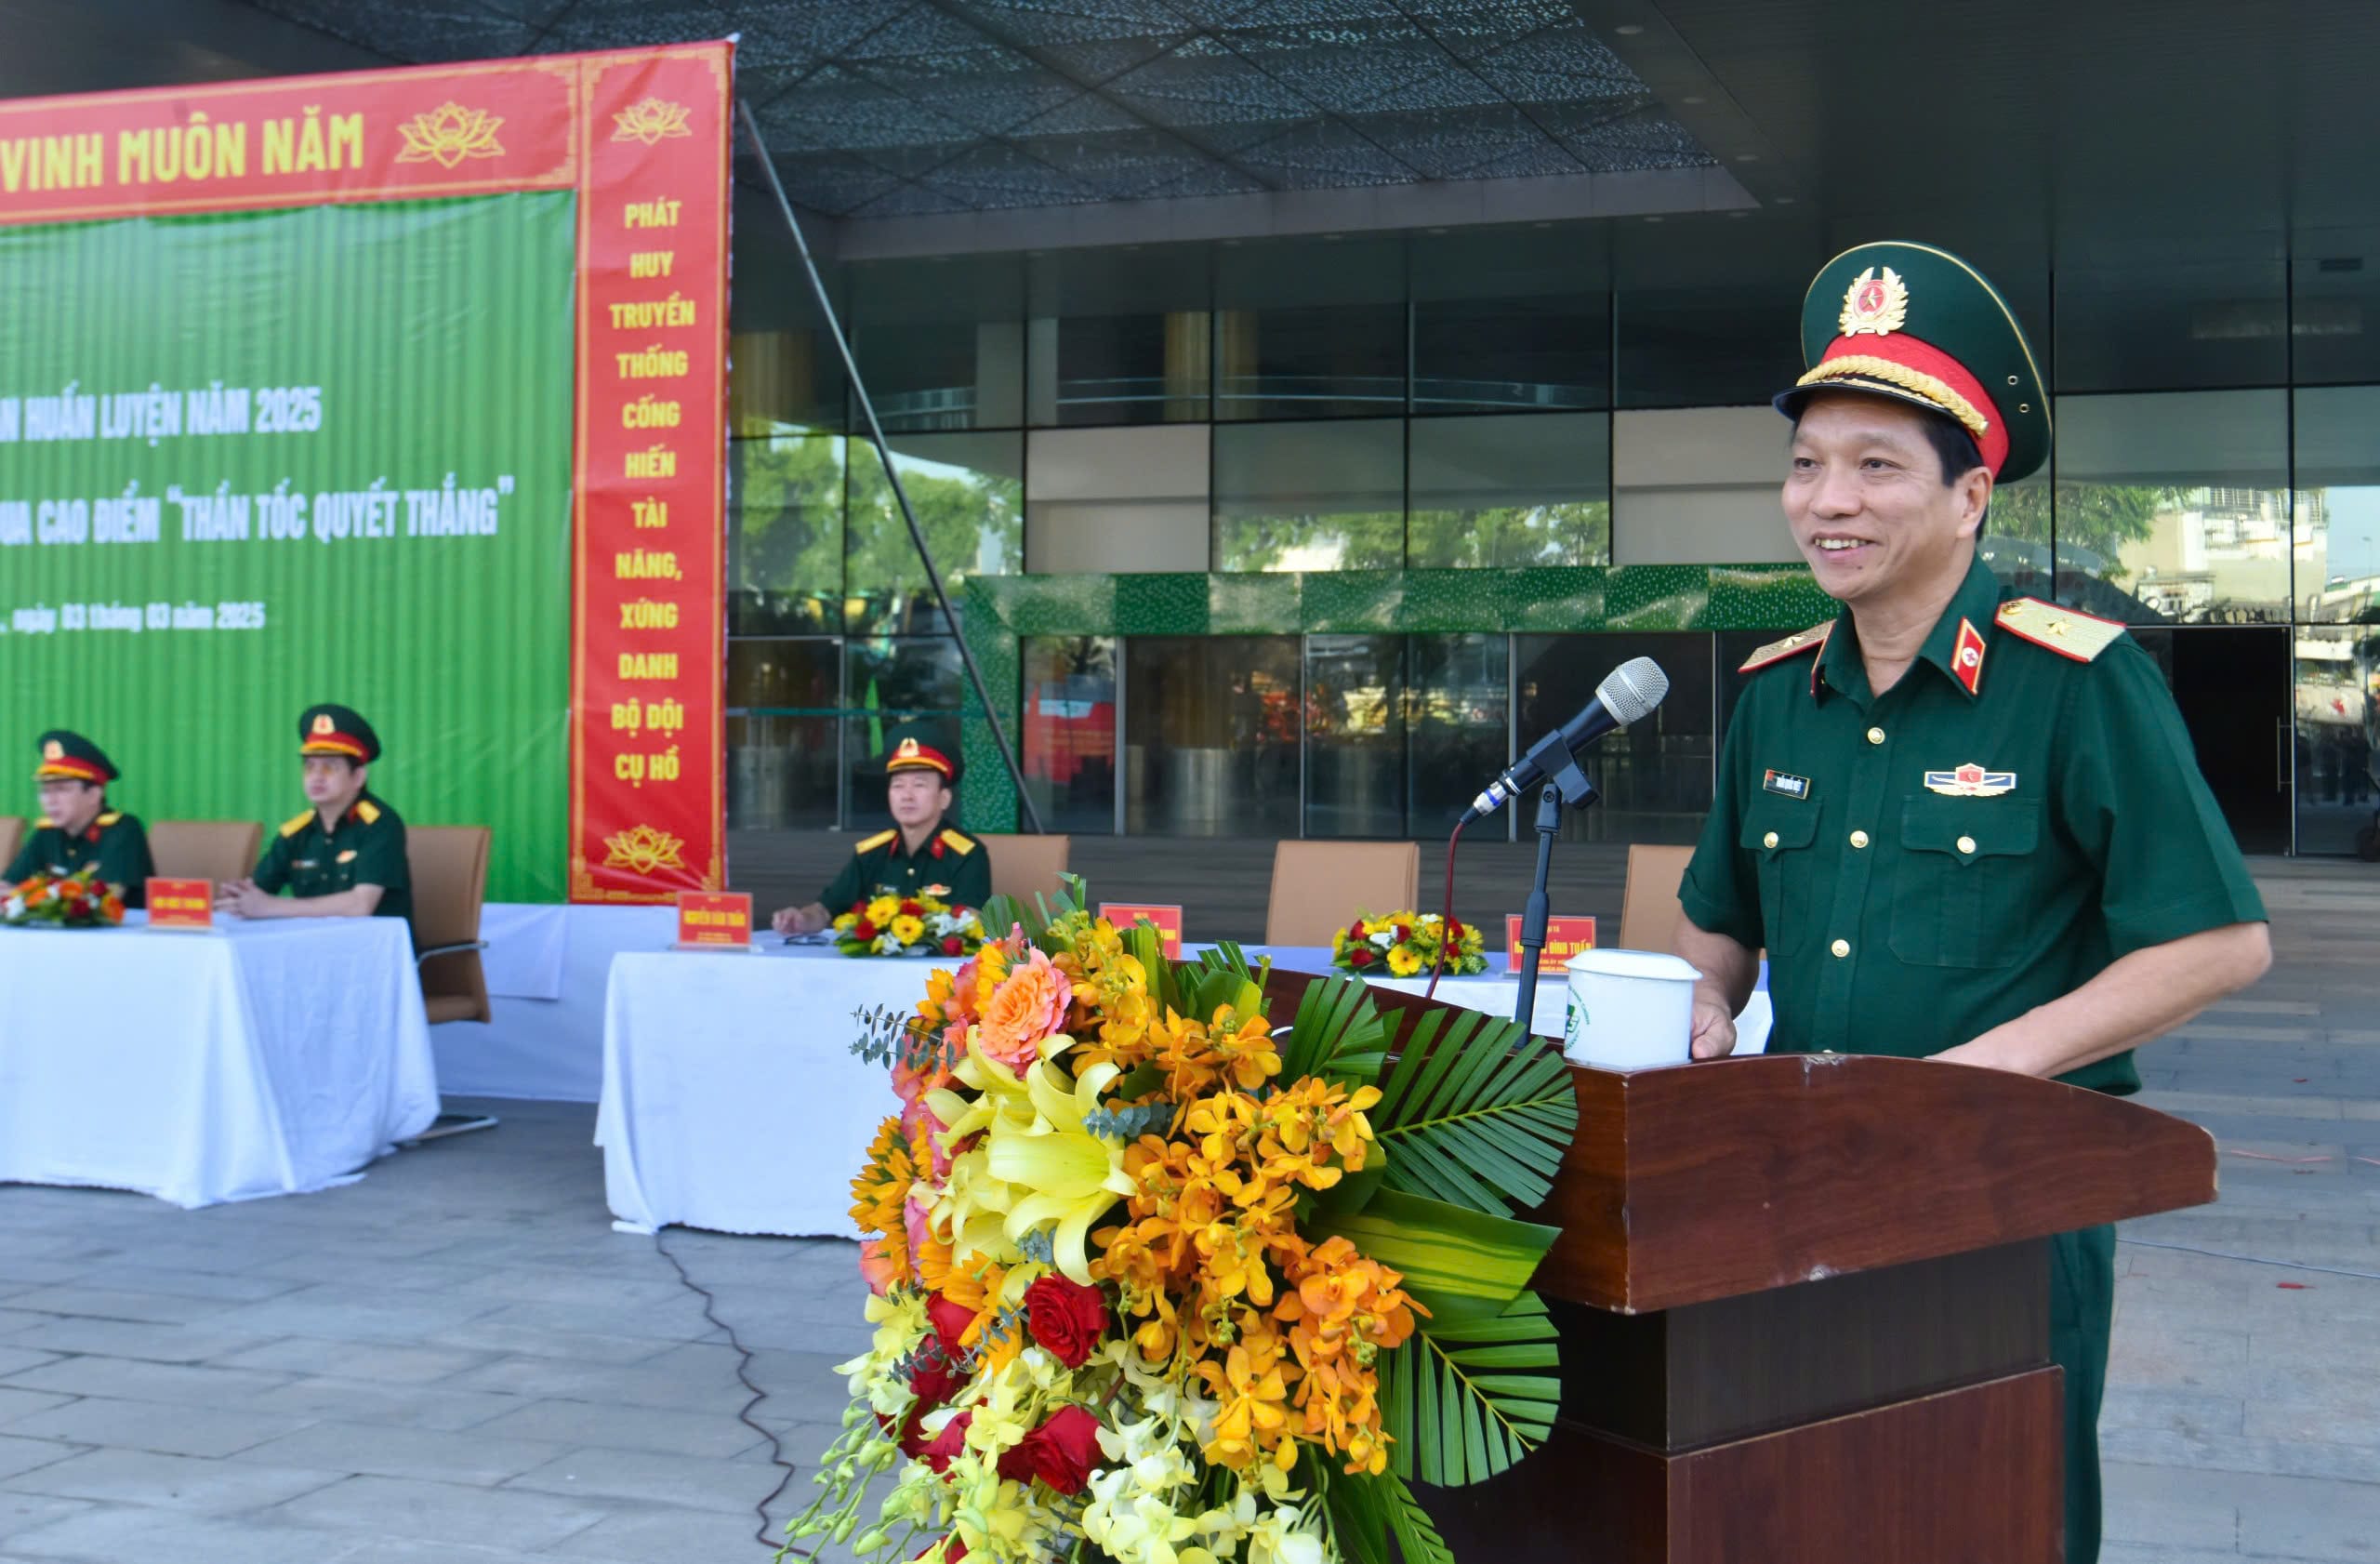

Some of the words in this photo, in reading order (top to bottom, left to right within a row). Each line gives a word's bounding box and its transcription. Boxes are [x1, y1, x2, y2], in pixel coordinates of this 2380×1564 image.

[0, 133, 103, 192] VINH
[118, 111, 245, 185] MUÔN
[262, 104, 363, 175] NĂM
[625, 196, 681, 229] PHÁT
[630, 251, 674, 279] HUY
[615, 343, 689, 379] THỐNG
[24, 379, 96, 441] HUẤN
[100, 381, 181, 447] LUYỆN
[187, 379, 250, 435] NĂM
[255, 386, 322, 433] 2025
[622, 393, 681, 430] CỐNG
[625, 443, 676, 479] HIẾN
[36, 498, 88, 544] CAO
[255, 477, 308, 539] TỐC
[313, 475, 399, 544] QUYẾT
[630, 496, 668, 528] TÀI
[216, 603, 266, 630] 2025
[619, 596, 679, 630] XỨNG
[618, 653, 679, 680] DANH
[611, 697, 641, 738] BỘ
[646, 697, 683, 738] ĐỘI
[615, 753, 644, 788] CỤ
